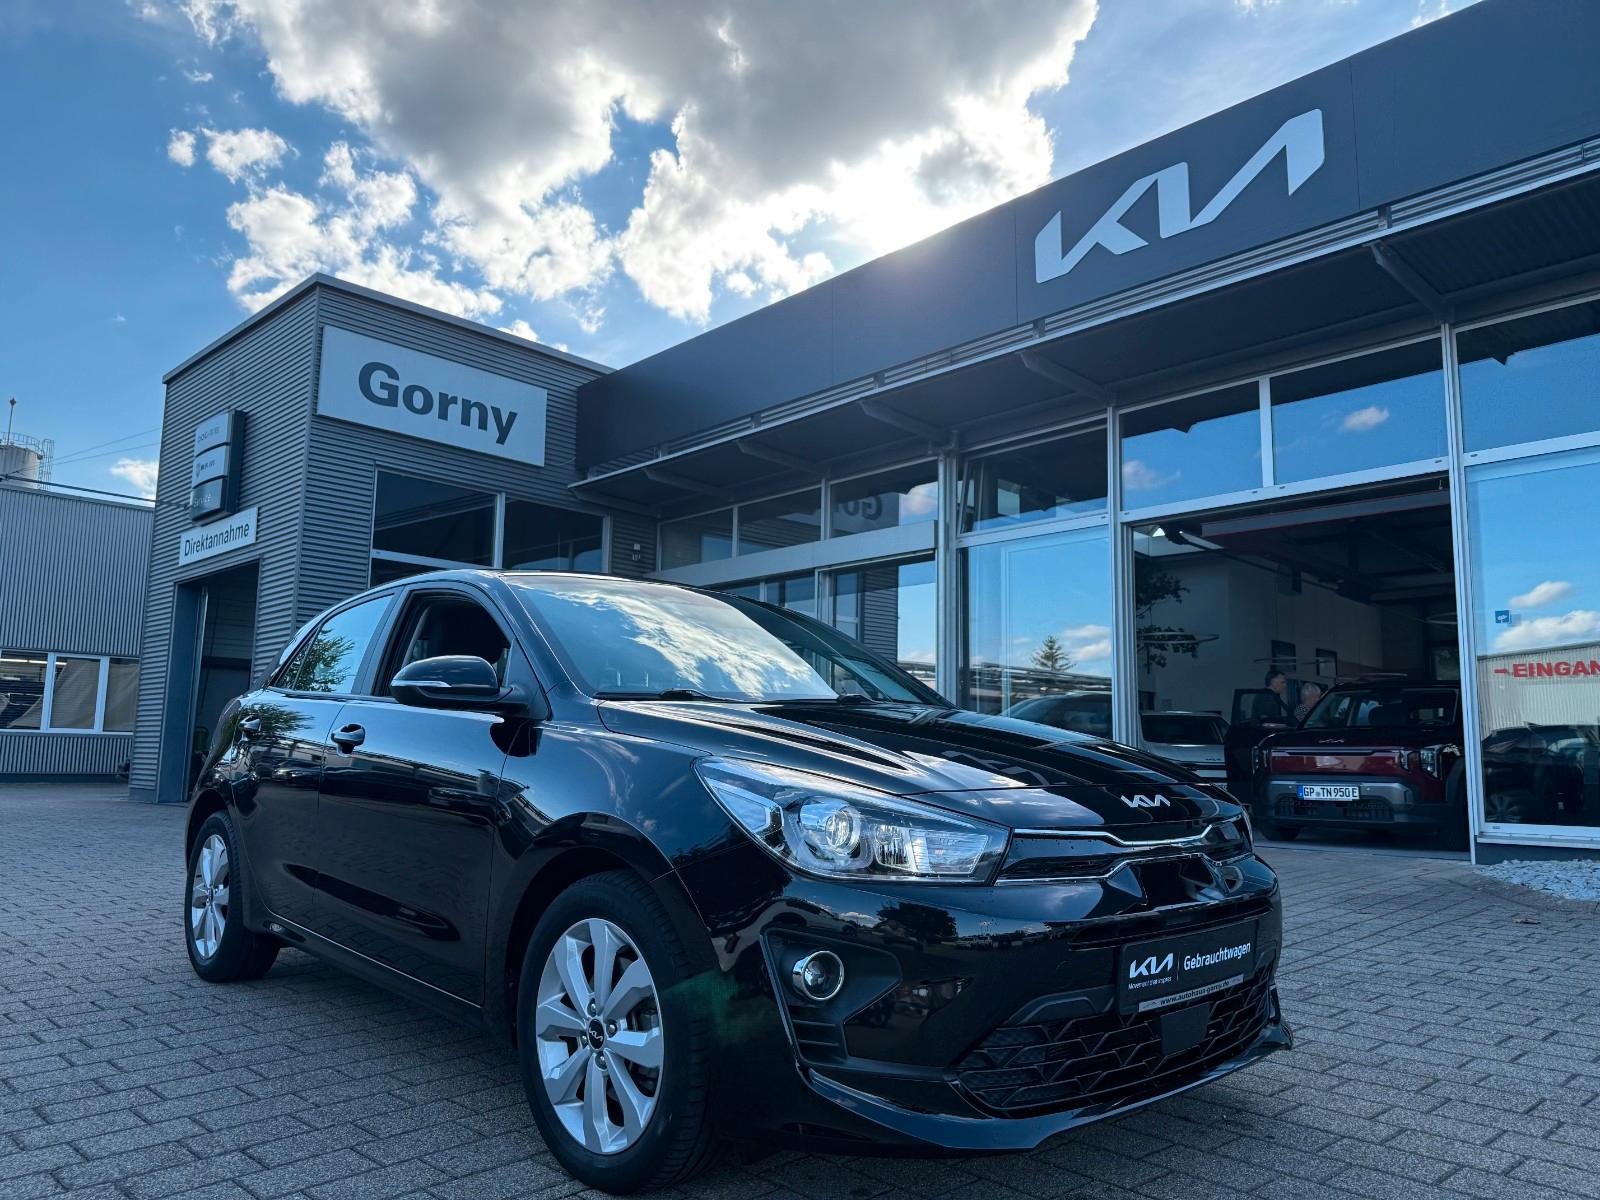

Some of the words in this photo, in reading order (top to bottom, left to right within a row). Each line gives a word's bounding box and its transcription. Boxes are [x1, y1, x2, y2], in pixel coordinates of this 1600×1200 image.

[1035, 108, 1325, 284] KIA
[358, 361, 518, 446] Gorny
[184, 523, 250, 557] Direktannahme
[1120, 794, 1171, 808] KIA
[1303, 786, 1315, 797] GP
[1320, 787, 1332, 798] TN
[1333, 787, 1351, 798] 950
[1351, 787, 1358, 798] E
[1129, 952, 1174, 979] KIA
[1183, 942, 1251, 971] Gebrauchtwagen
